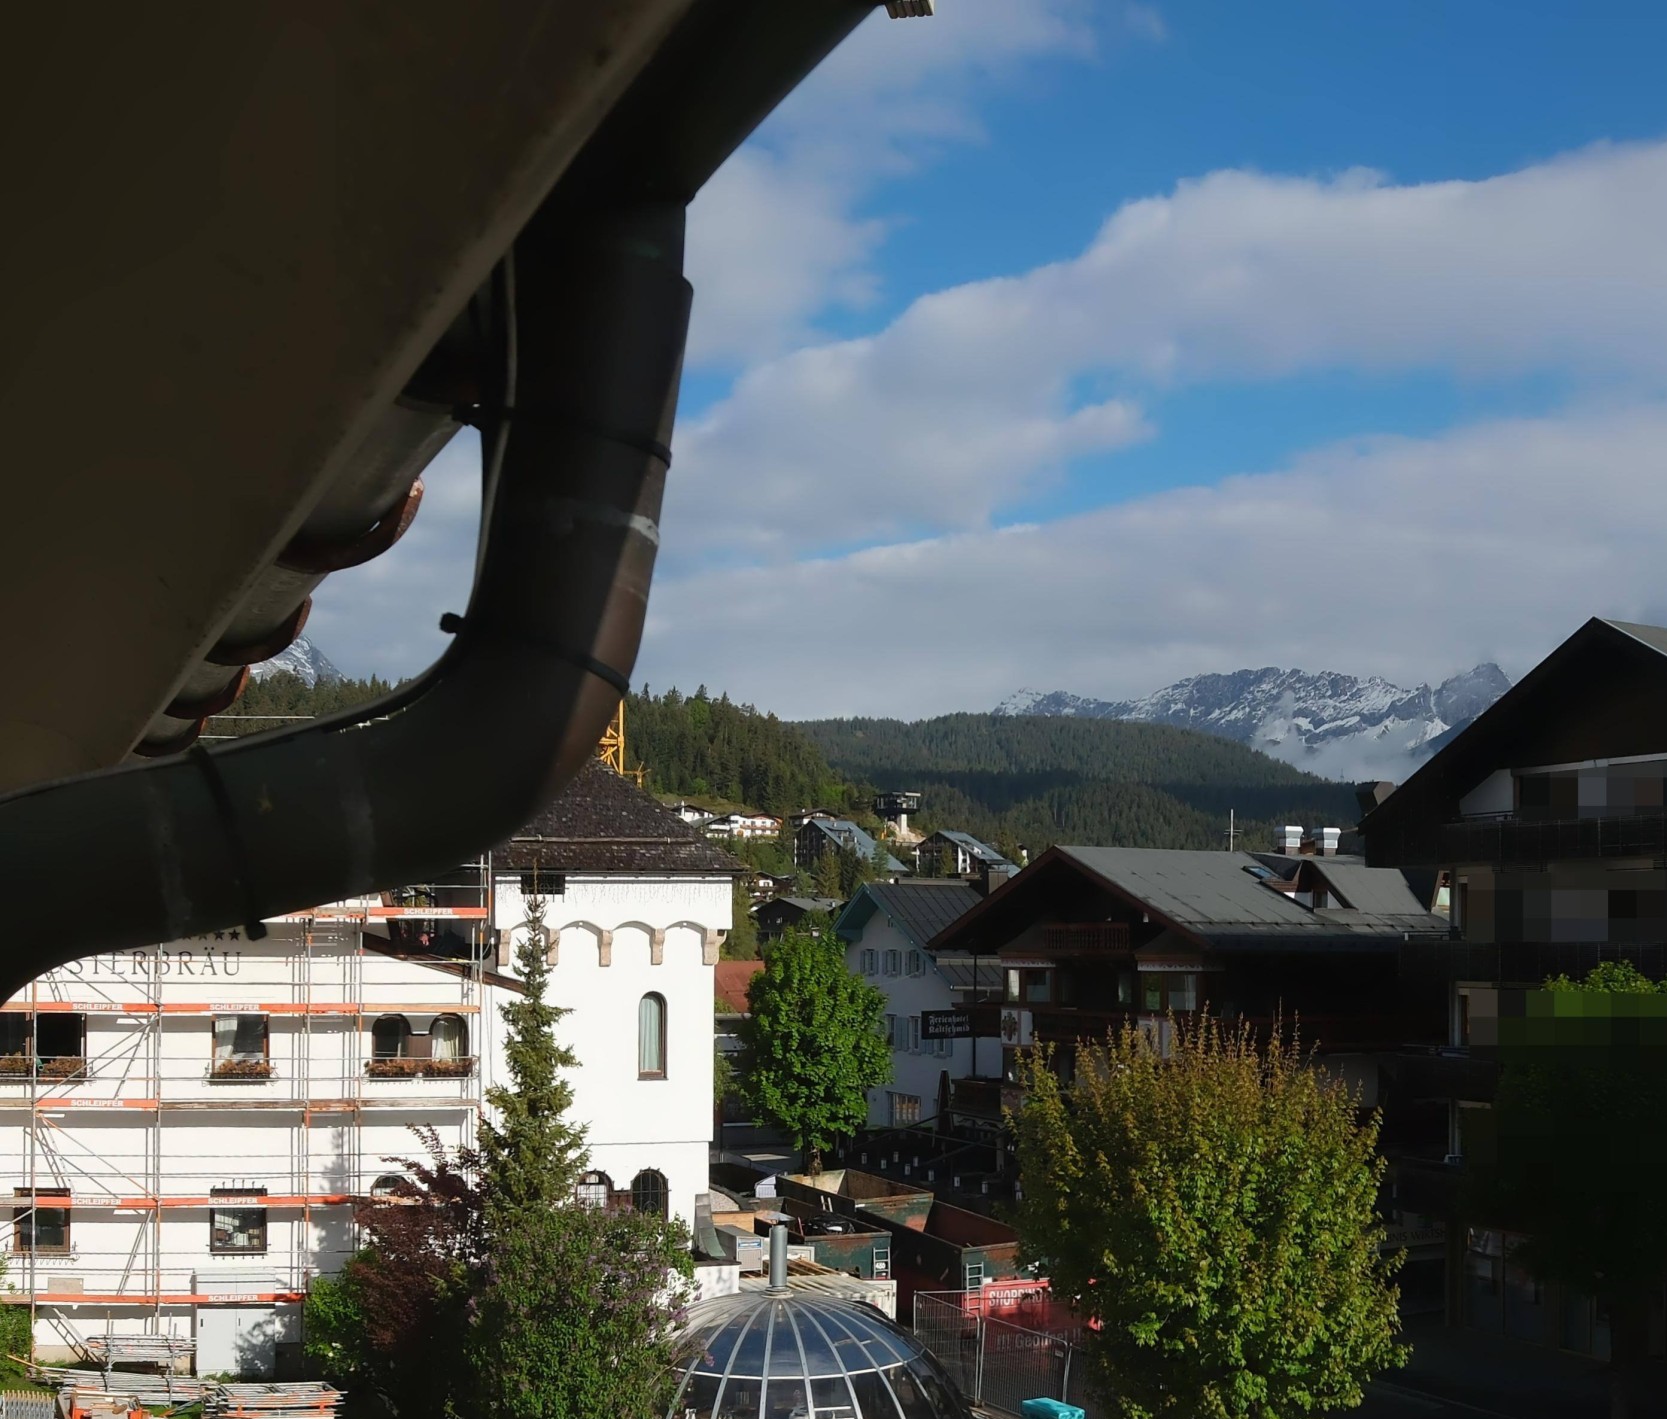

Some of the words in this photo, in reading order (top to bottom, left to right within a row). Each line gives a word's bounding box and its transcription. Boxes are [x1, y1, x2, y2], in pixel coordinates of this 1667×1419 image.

[72, 1003, 123, 1011] SCHLEIPFER
[209, 1003, 260, 1011] SCHLEIPFER
[208, 1197, 258, 1205] SCHLEIPFER
